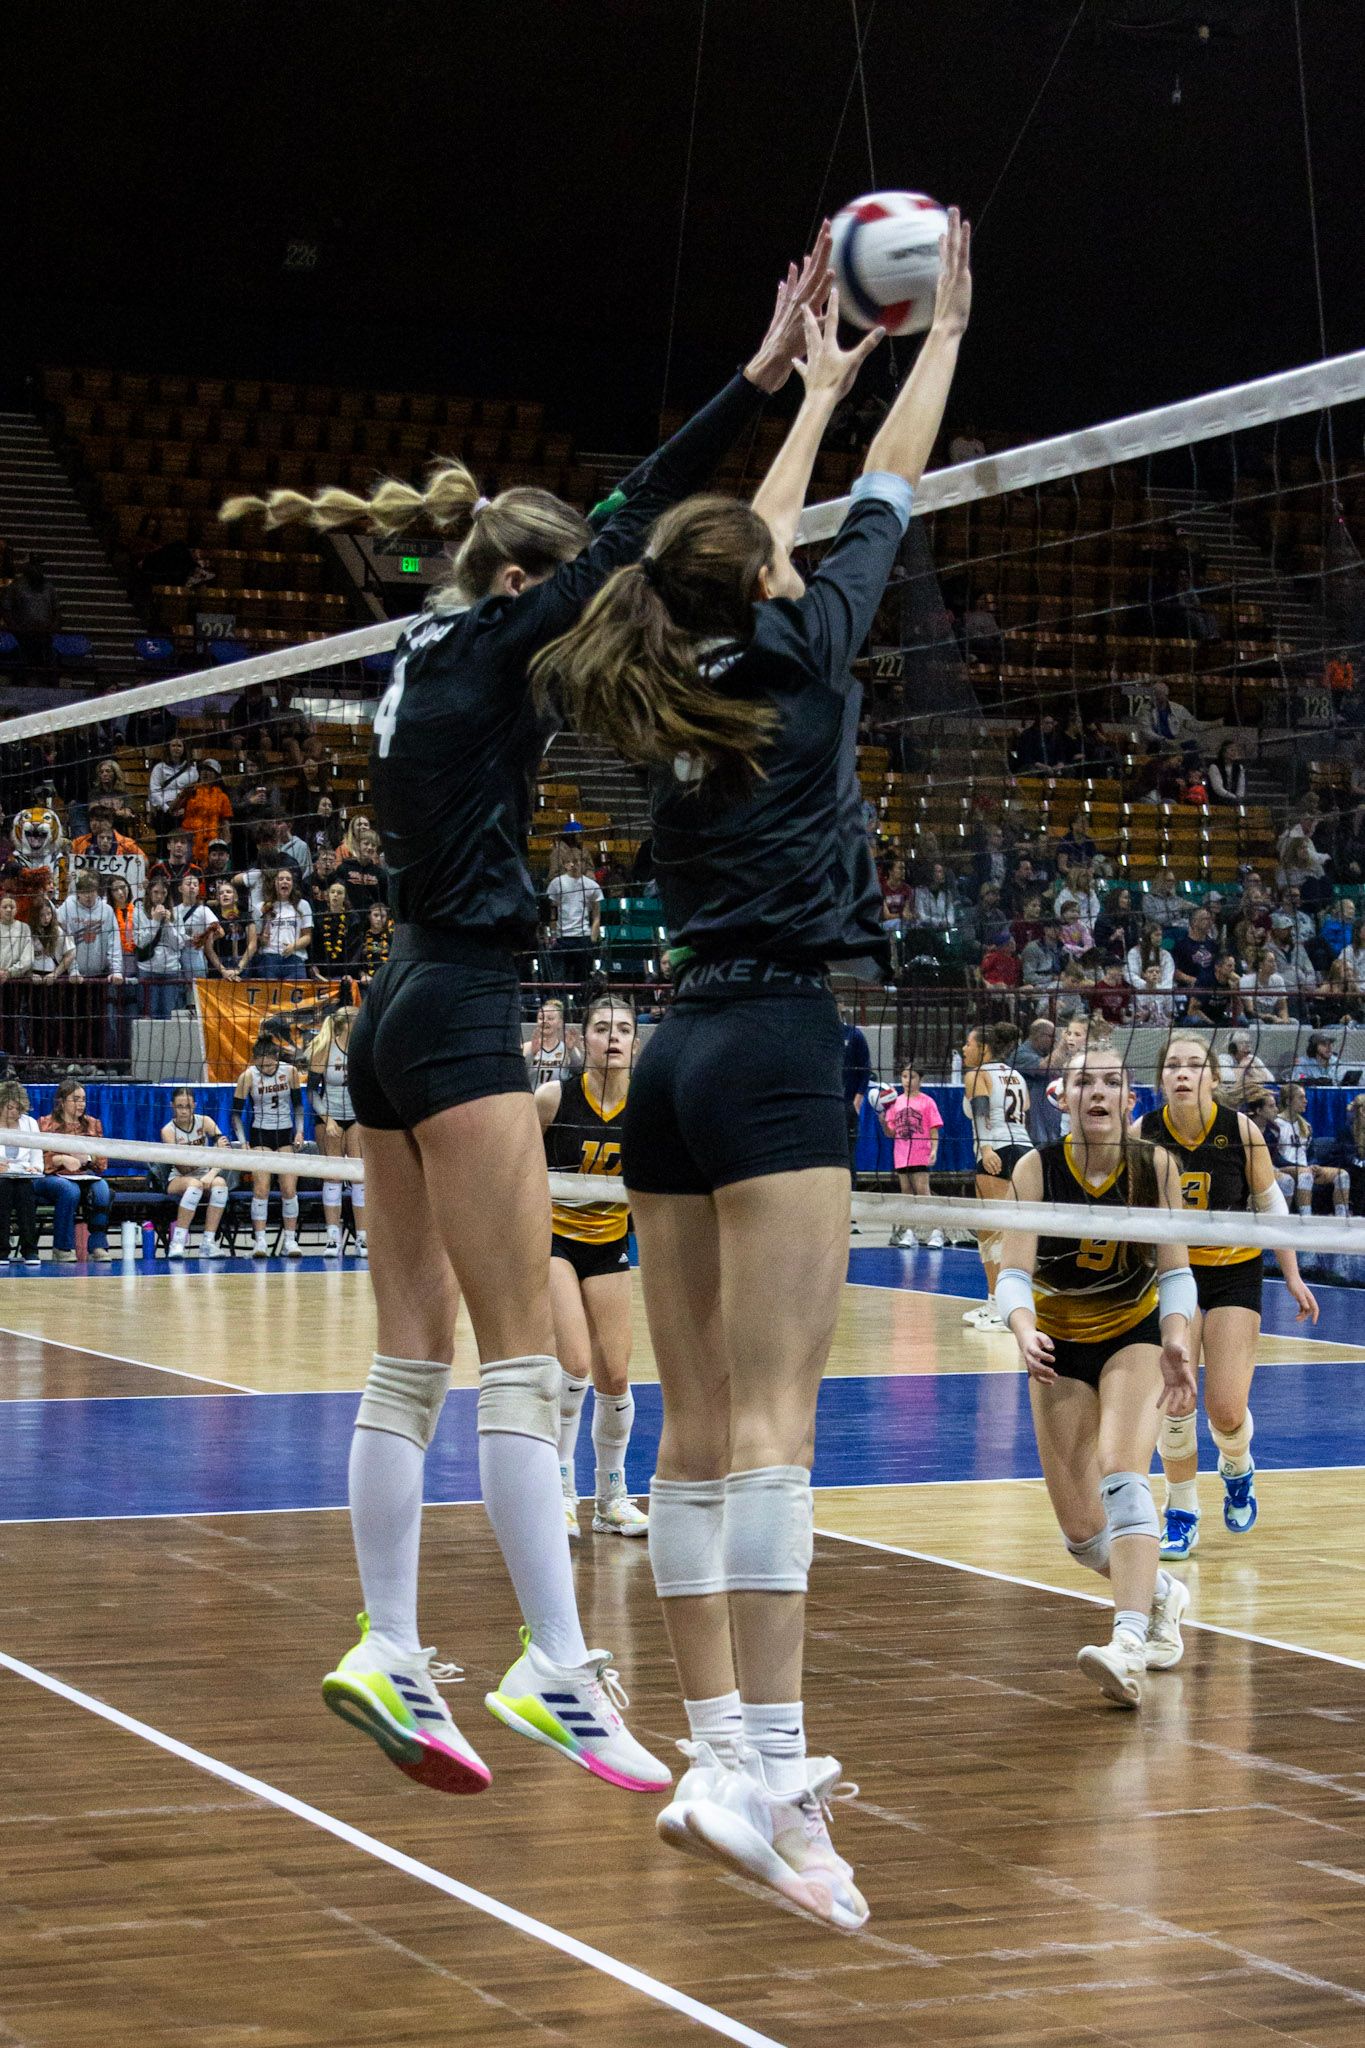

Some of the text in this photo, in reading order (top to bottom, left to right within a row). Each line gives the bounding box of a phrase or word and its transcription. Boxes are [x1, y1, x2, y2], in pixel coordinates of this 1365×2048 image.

[402, 557, 419, 572] EXIT
[876, 655, 905, 677] 227
[1304, 695, 1329, 719] 128
[540, 1069, 554, 1084] 17
[258, 1083, 289, 1095] WIGGINS
[271, 1096, 279, 1109] 5
[1004, 1088, 1024, 1125] 21
[577, 1139, 624, 1176] 10
[1180, 1171, 1212, 1210] 3
